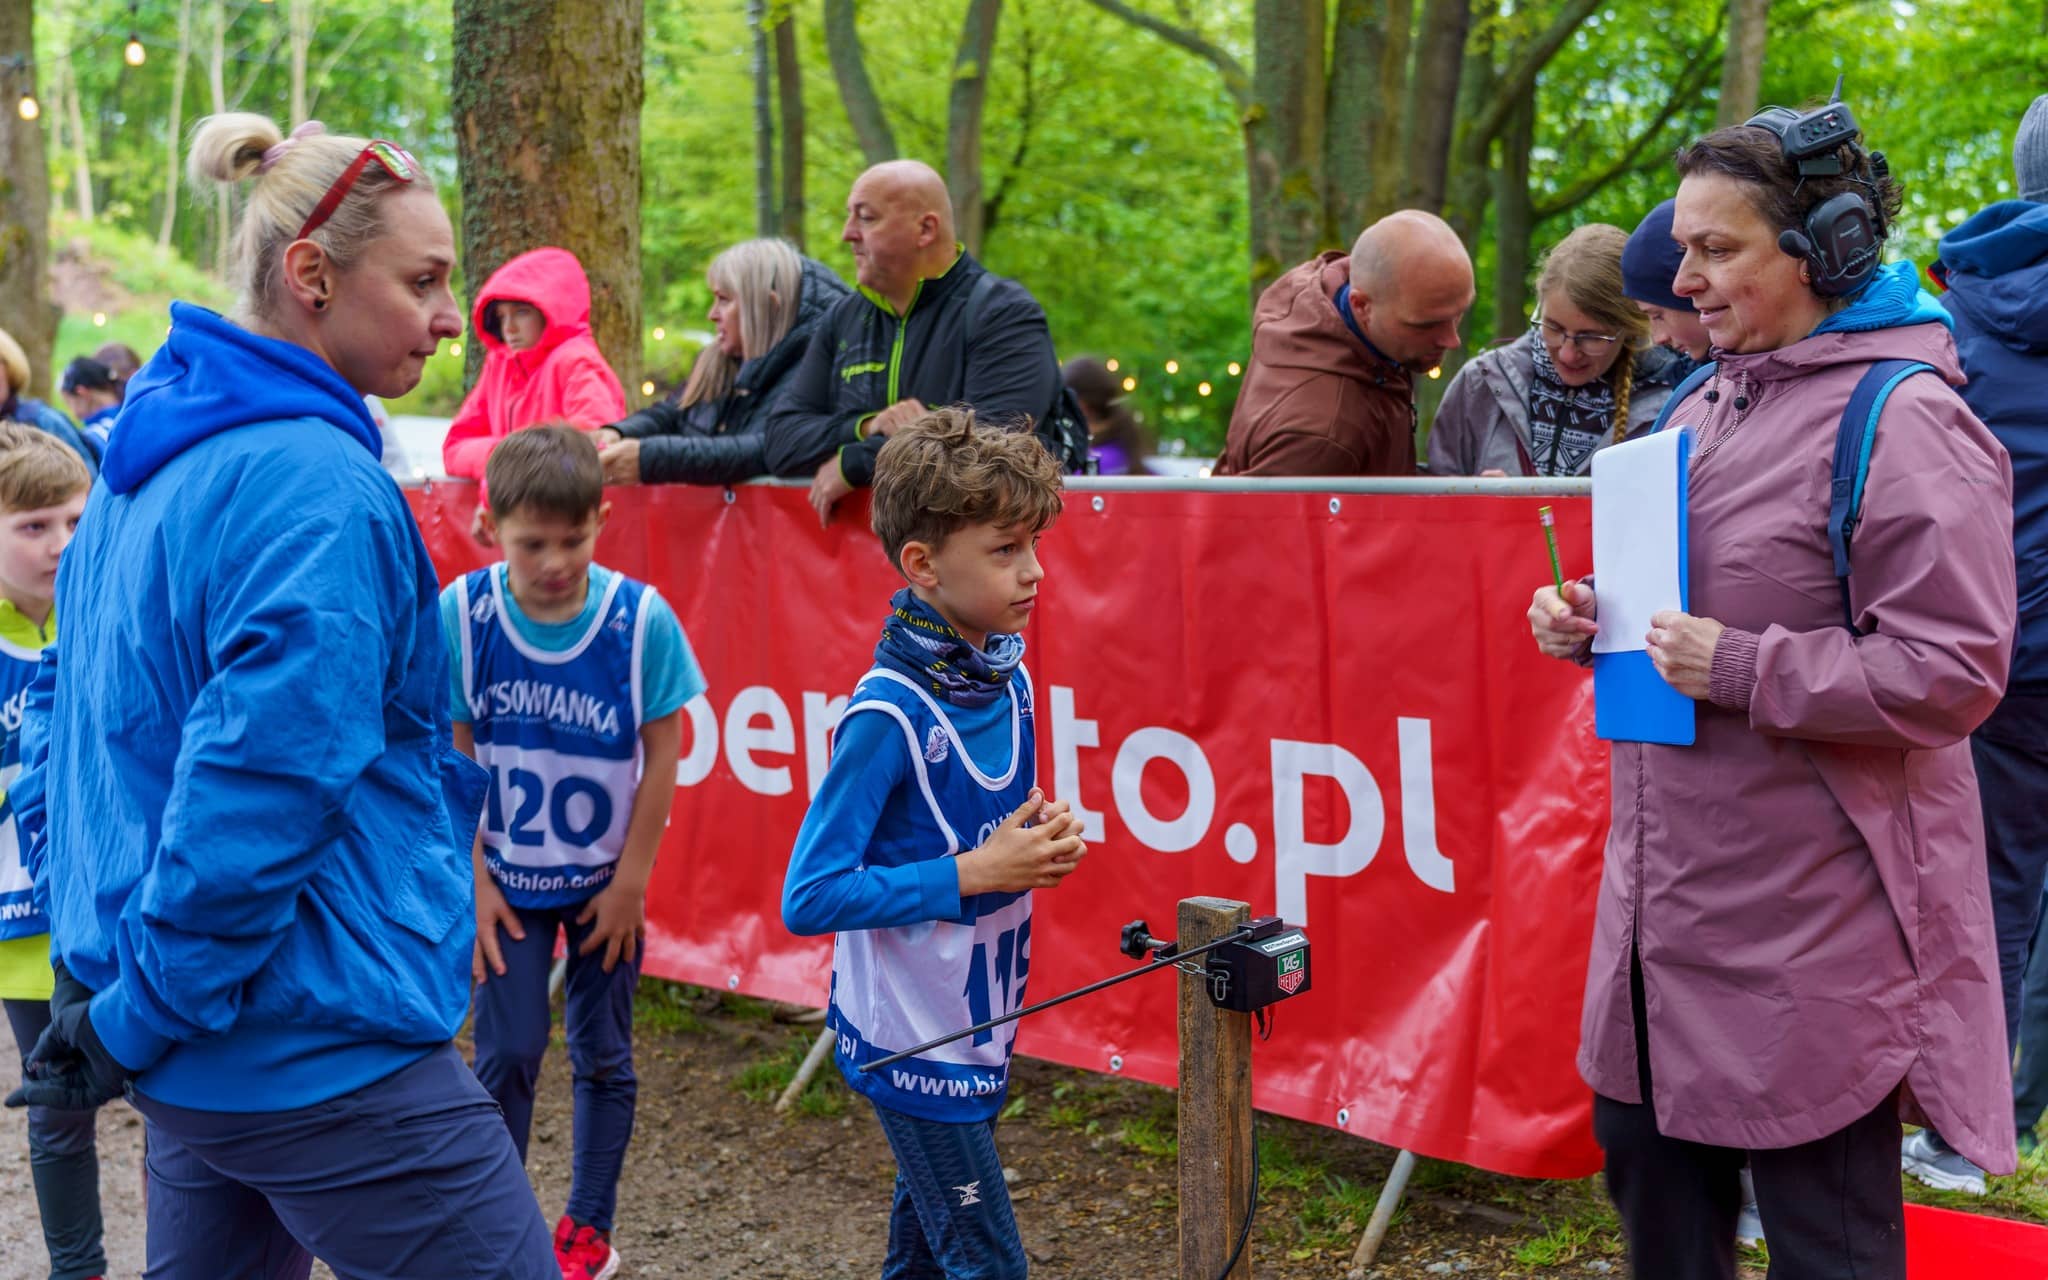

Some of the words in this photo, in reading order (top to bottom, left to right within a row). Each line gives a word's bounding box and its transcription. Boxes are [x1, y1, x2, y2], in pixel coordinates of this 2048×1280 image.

[487, 764, 613, 849] 120
[1281, 953, 1301, 973] TAG
[1279, 969, 1304, 991] HEUER
